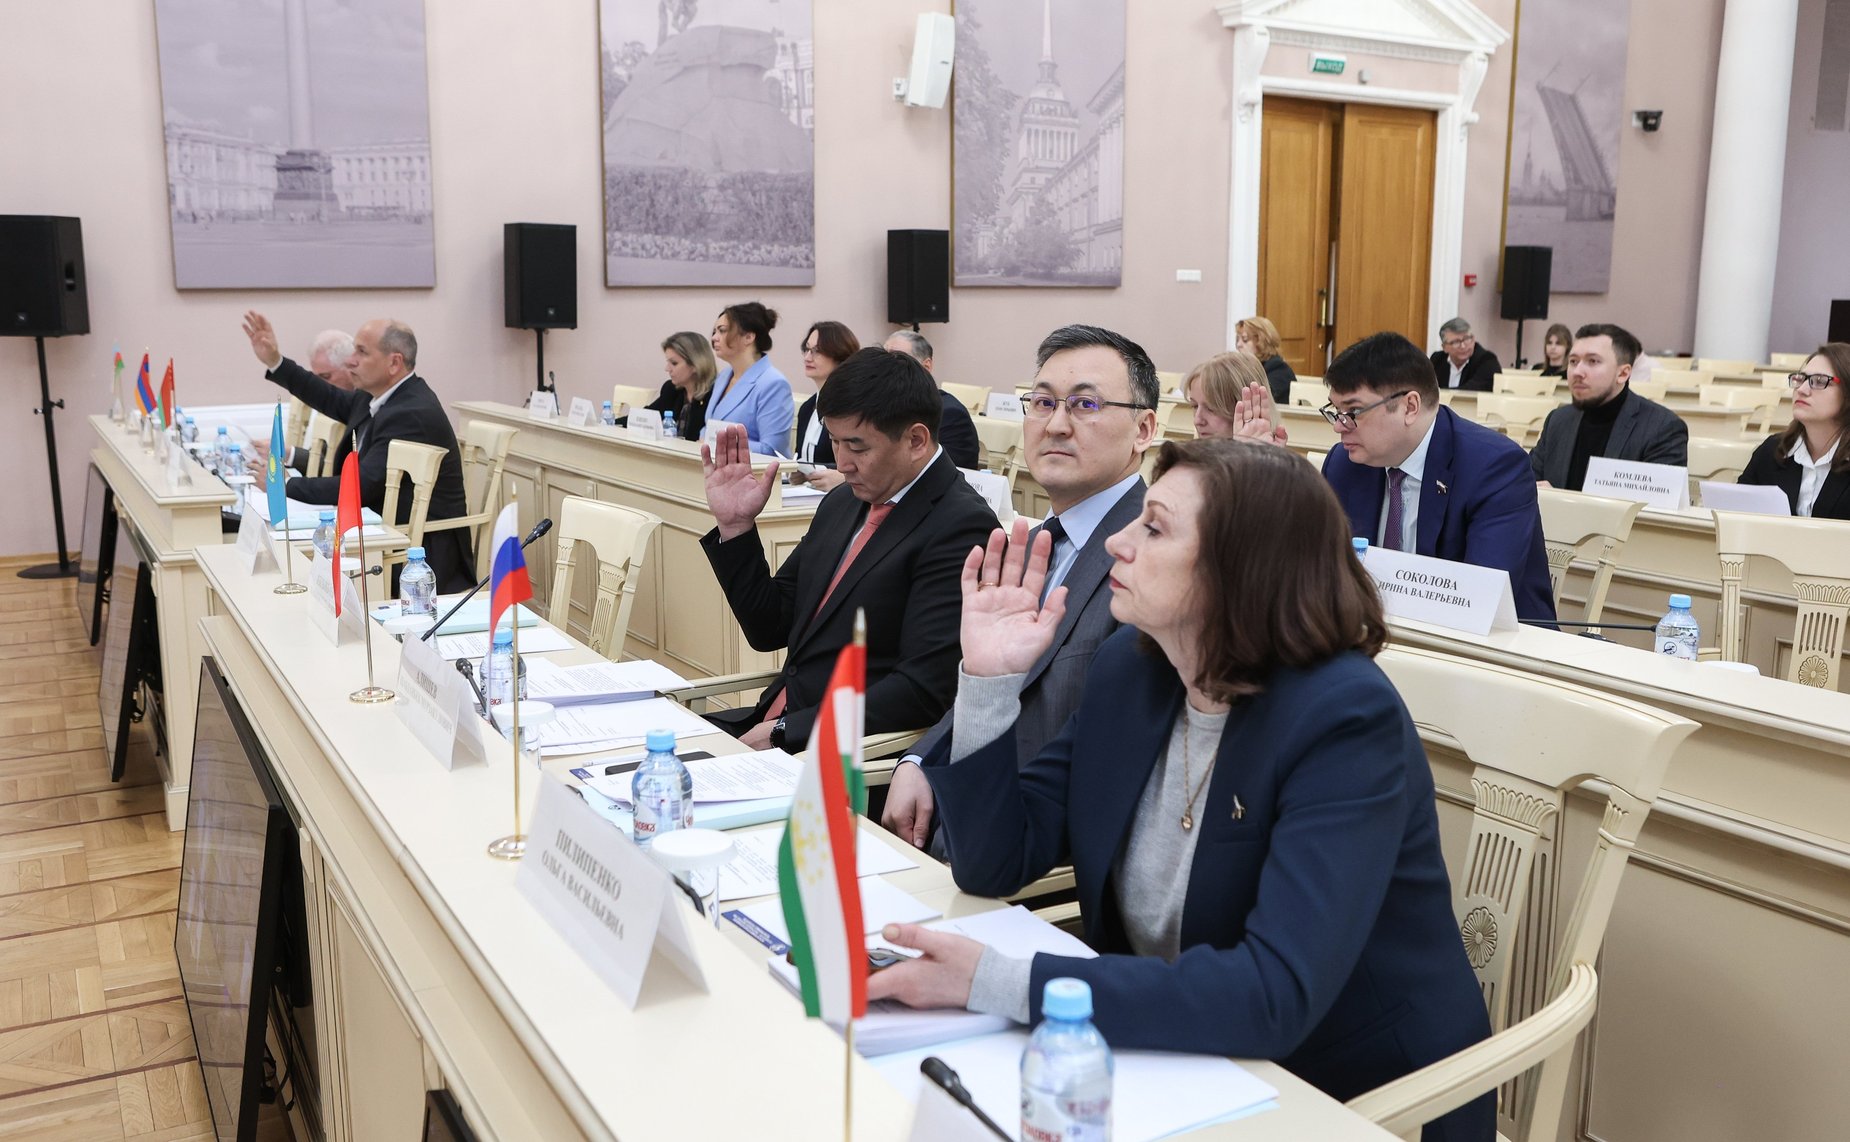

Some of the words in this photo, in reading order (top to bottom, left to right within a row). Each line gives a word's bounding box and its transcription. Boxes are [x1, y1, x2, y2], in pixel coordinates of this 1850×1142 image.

[1594, 479, 1622, 488] ТАТЬЯНА
[1623, 482, 1670, 494] МИХАЙЛОВНА
[1613, 471, 1652, 482] КОМЛЕВА
[1395, 569, 1458, 590] СОКОЛОВА
[1378, 580, 1408, 595] ИРИНА
[1410, 587, 1471, 608] ВАЛЕРЬЕВНА
[555, 828, 622, 901] ПИЛИПЕНКО
